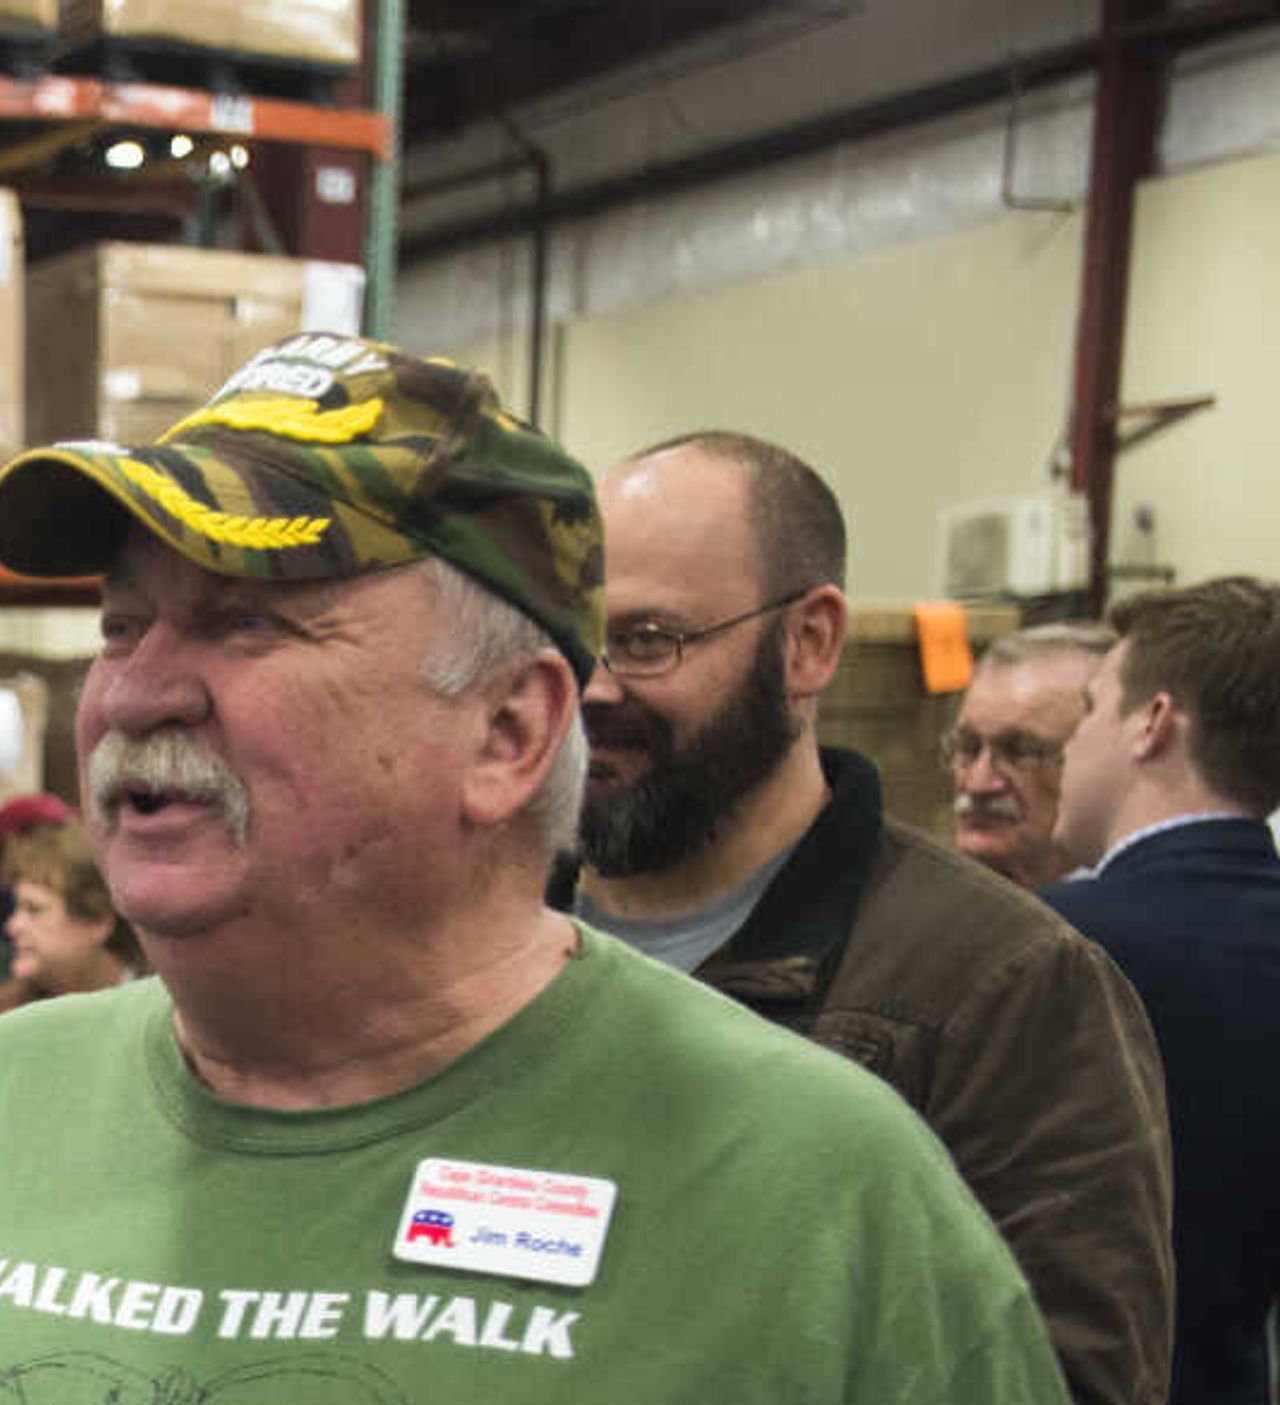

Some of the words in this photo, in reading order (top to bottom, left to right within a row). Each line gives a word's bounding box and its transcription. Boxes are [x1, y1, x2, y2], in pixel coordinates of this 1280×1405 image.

[470, 1226, 508, 1248] Jim
[514, 1230, 583, 1258] Roche
[218, 1288, 350, 1340] THE
[362, 1291, 580, 1359] WALK
